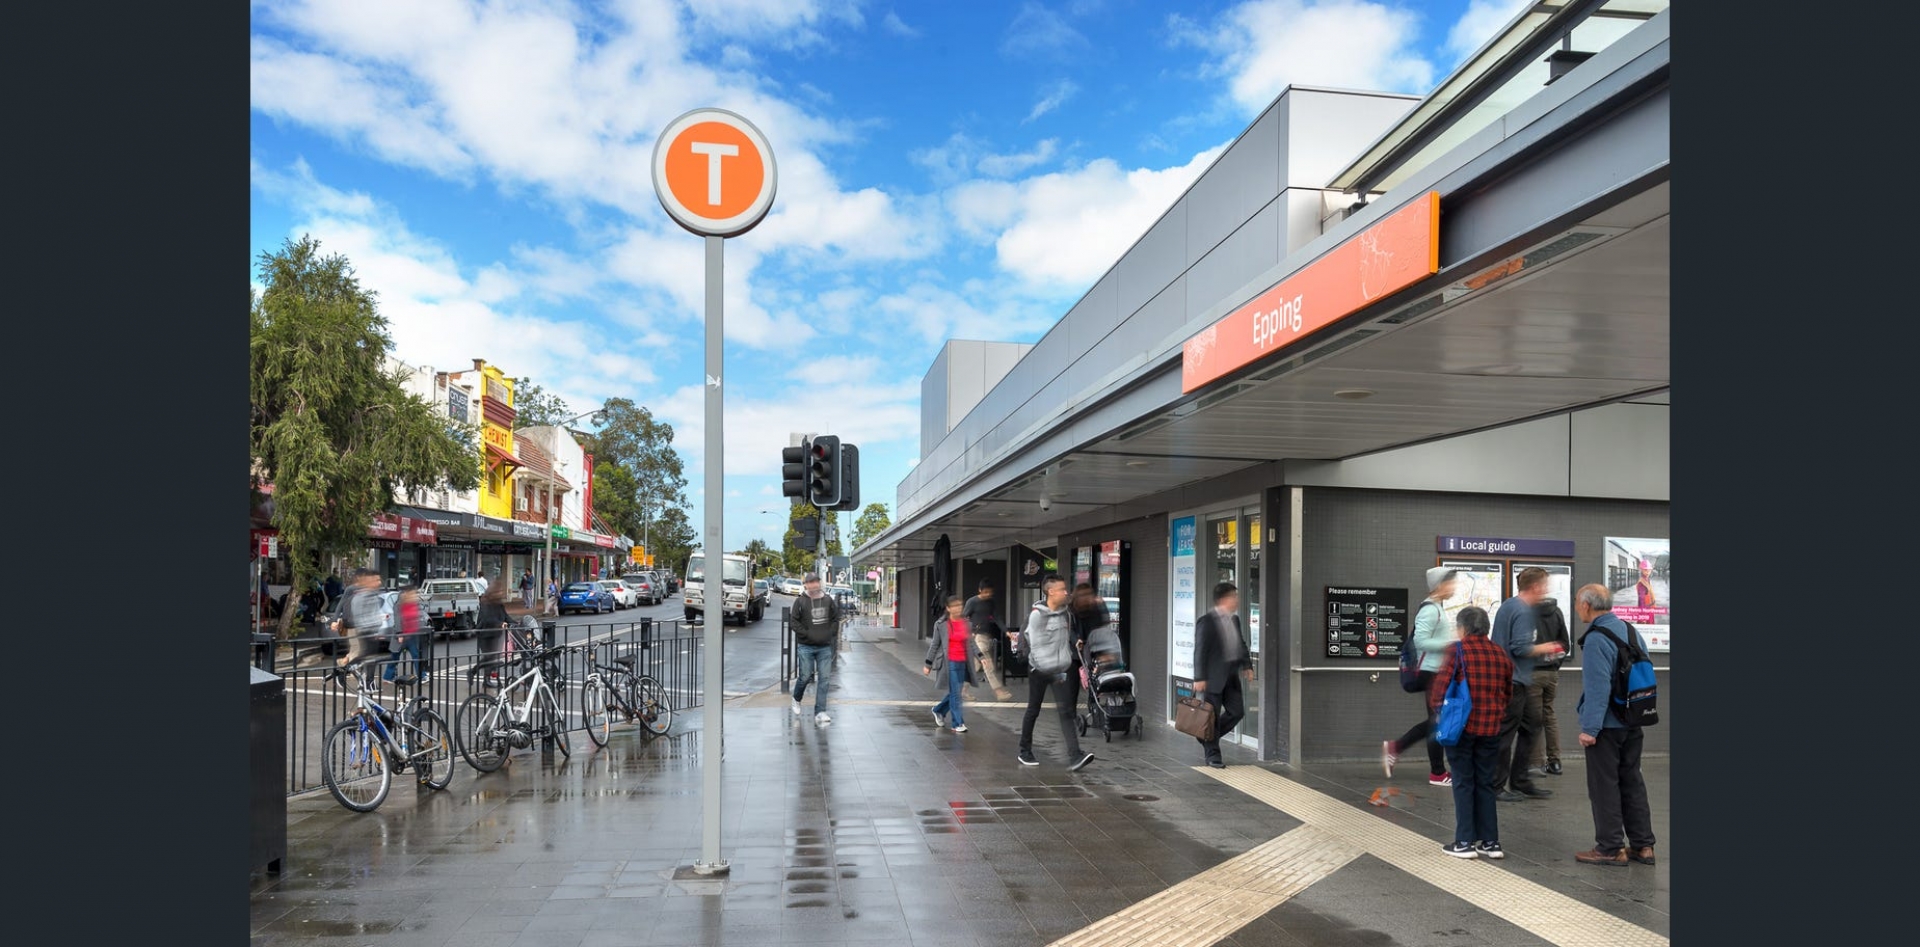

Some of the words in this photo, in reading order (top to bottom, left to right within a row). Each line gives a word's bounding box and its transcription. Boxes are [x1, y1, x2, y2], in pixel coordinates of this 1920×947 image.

[690, 141, 739, 206] T
[1252, 294, 1303, 349] Epping
[1180, 525, 1191, 536] FOR
[1460, 540, 1487, 550] Local
[1488, 541, 1516, 553] guide
